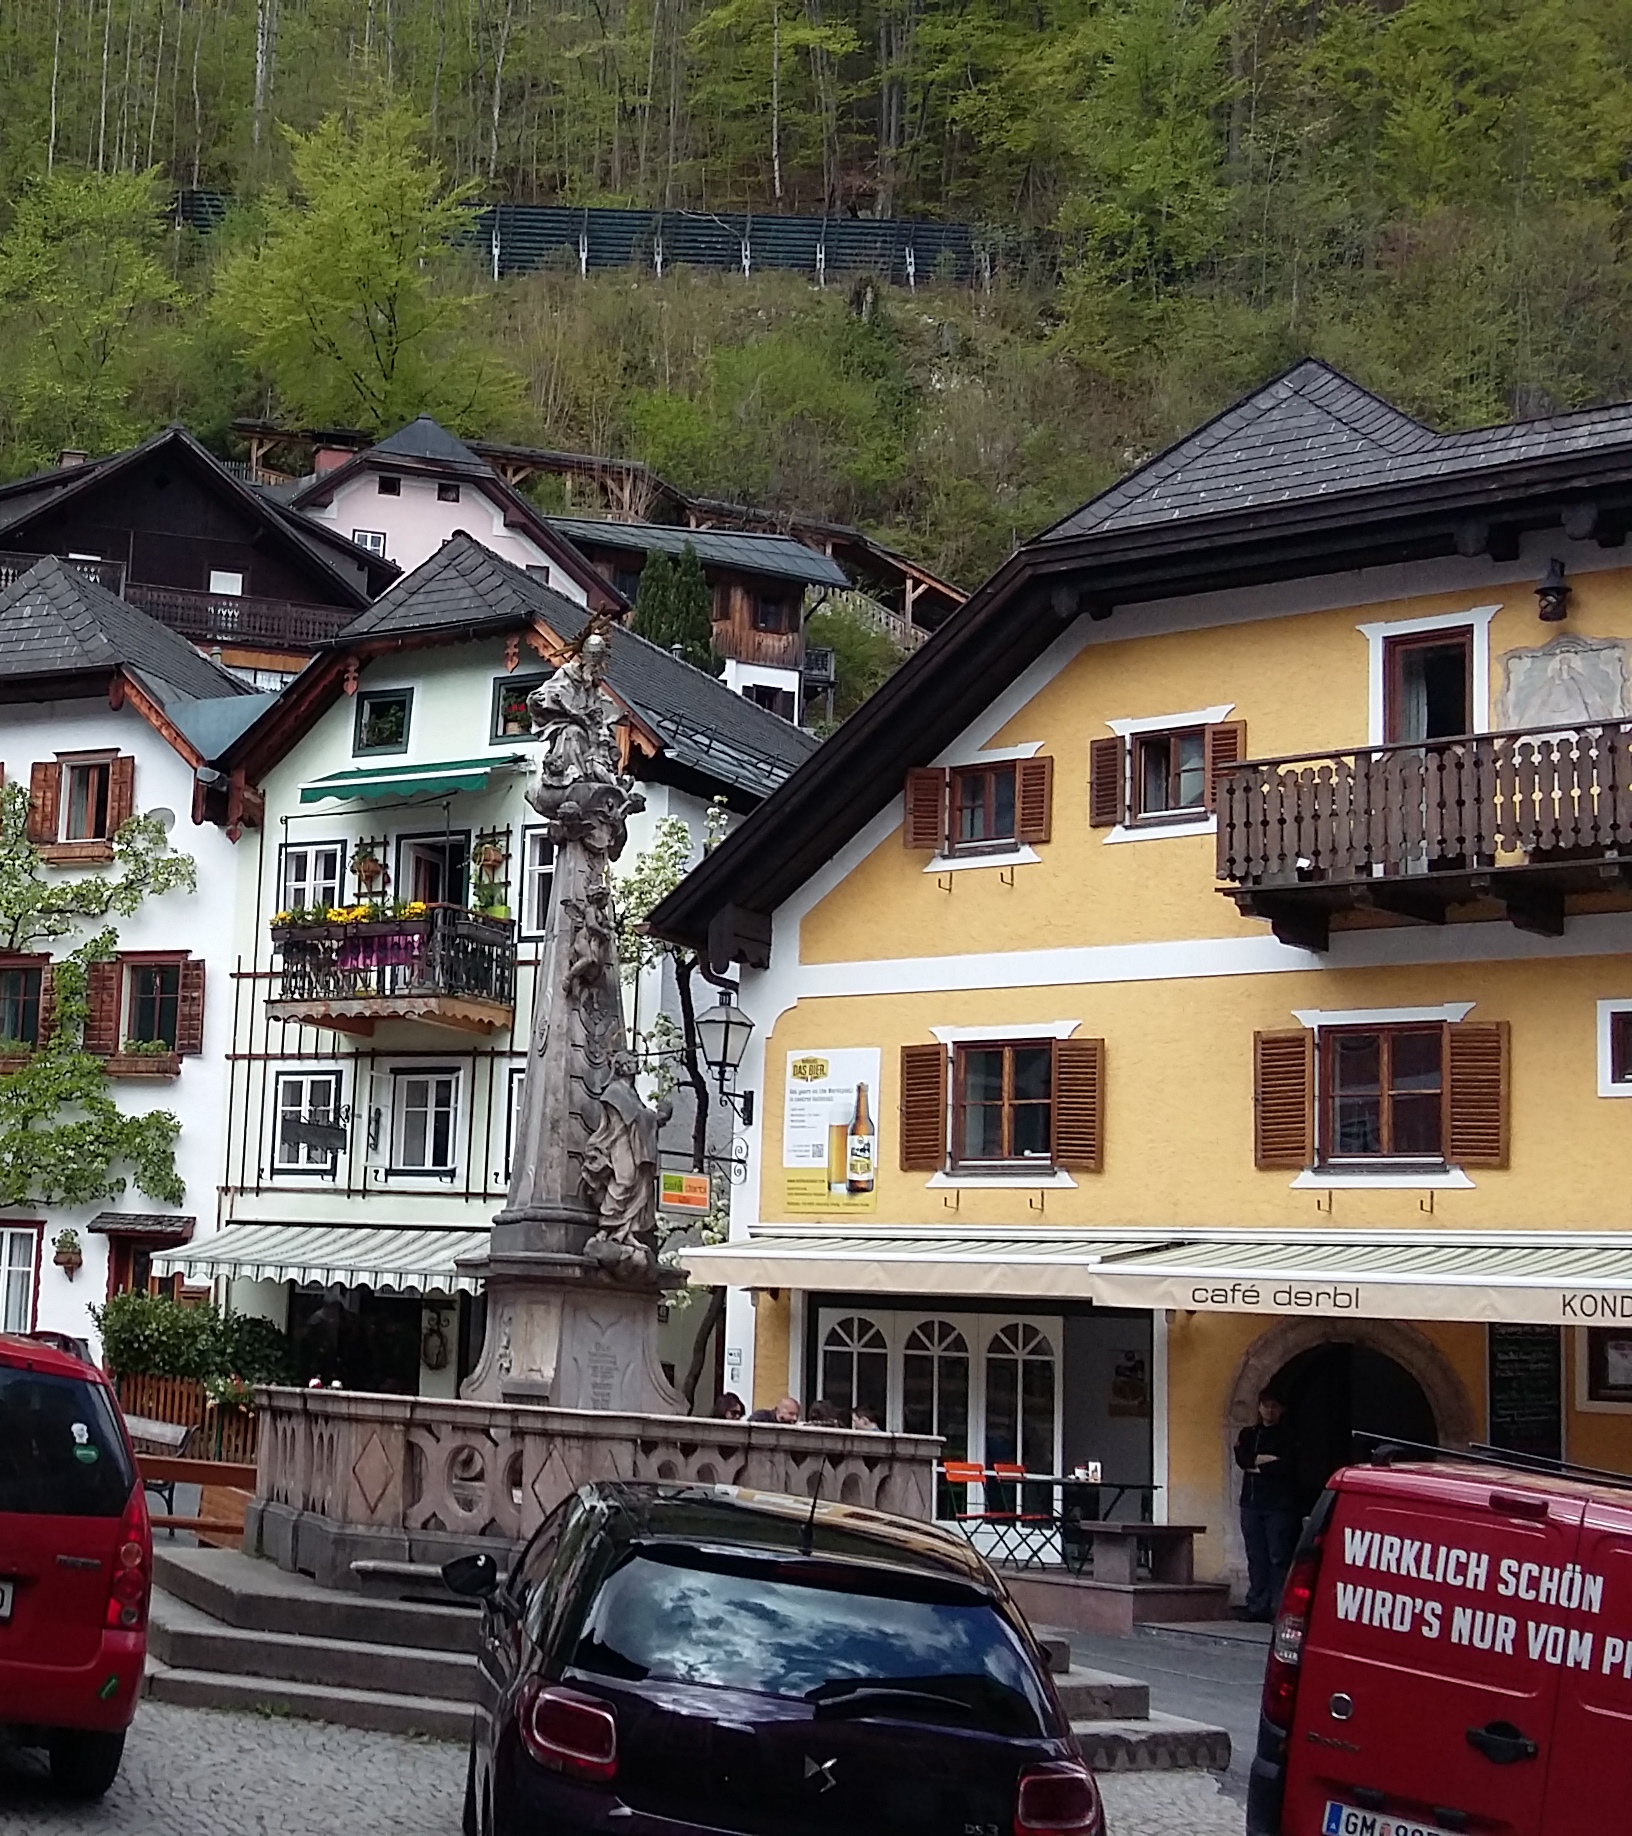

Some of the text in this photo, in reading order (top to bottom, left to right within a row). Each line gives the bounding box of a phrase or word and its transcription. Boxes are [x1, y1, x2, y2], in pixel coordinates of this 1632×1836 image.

[792, 1064, 807, 1077] DAS
[1191, 1282, 1261, 1306] café
[1561, 1293, 1632, 1319] KOND
[1343, 1526, 1605, 1615] WIRKLICH SCHÖN
[1449, 1605, 1518, 1656] NUR
[1526, 1619, 1594, 1672] VOM
